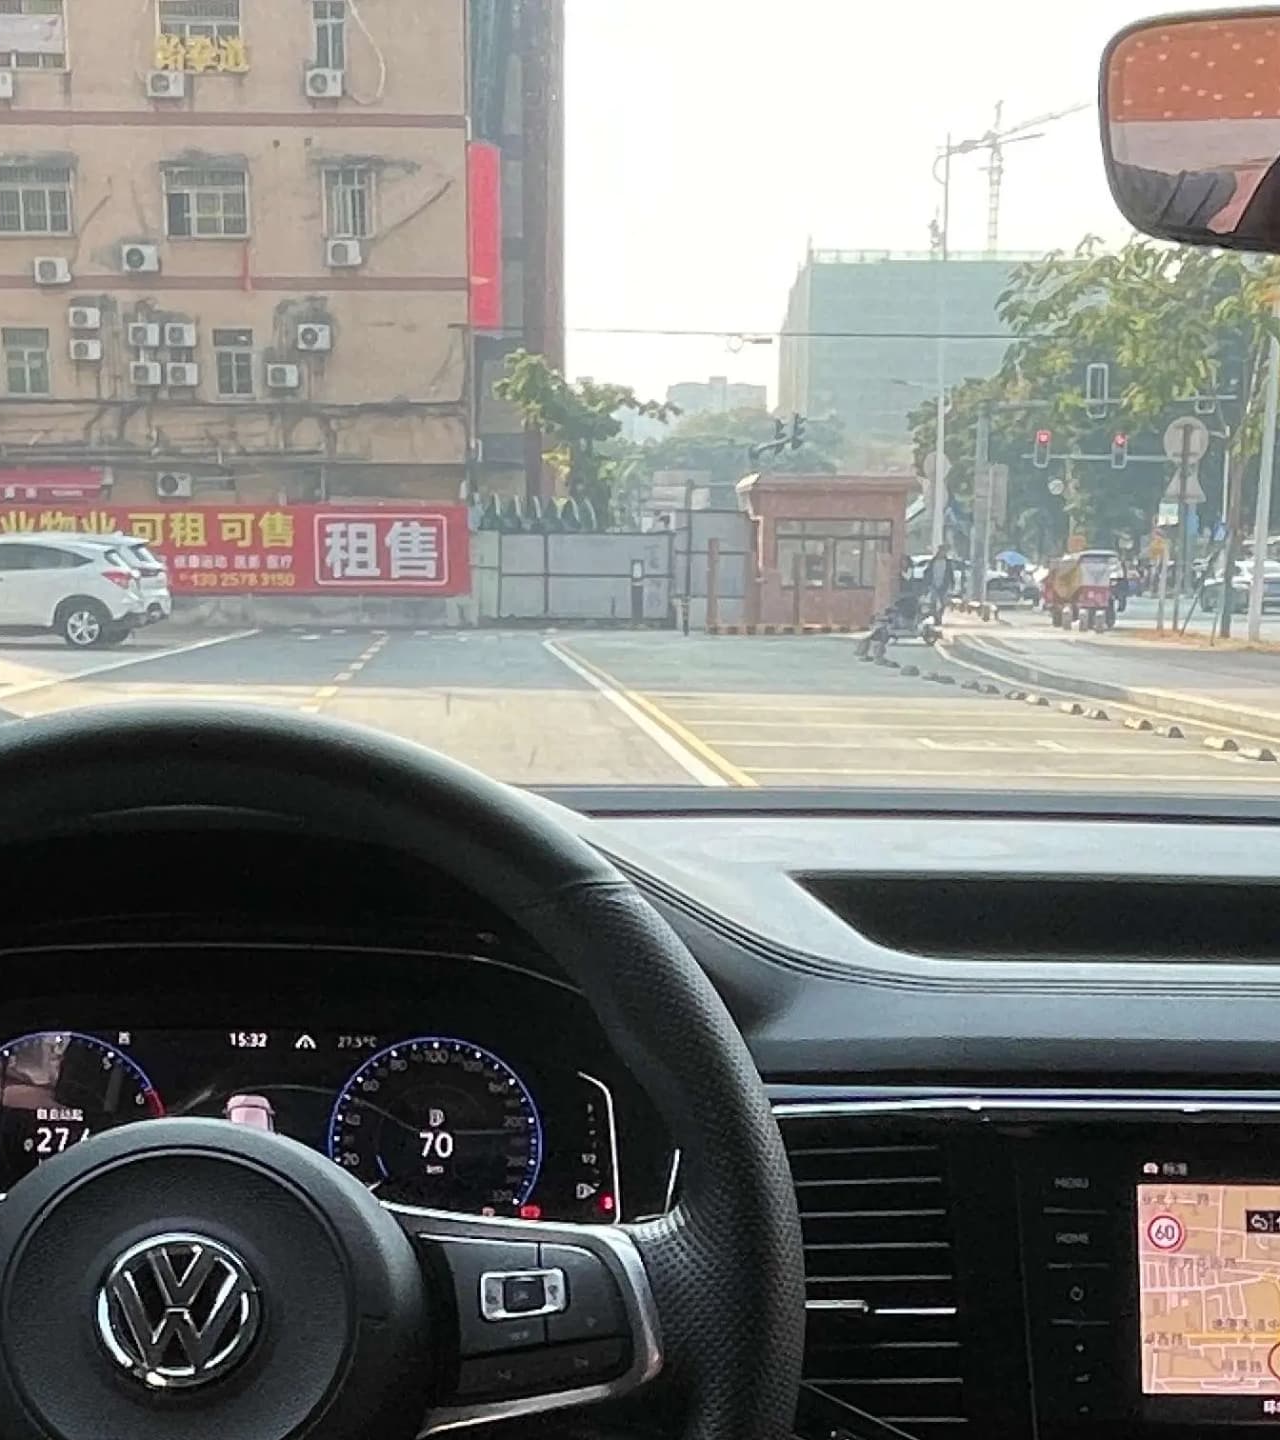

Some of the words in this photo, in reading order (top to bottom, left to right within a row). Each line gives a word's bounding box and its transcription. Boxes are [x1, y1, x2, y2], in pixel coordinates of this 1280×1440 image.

[128, 512, 206, 547] 可租
[217, 512, 293, 547] 可售
[325, 521, 438, 578] 租售
[229, 1032, 267, 1048] 15:32
[420, 1132, 454, 1158] 70
[1154, 1225, 1176, 1241] 60
